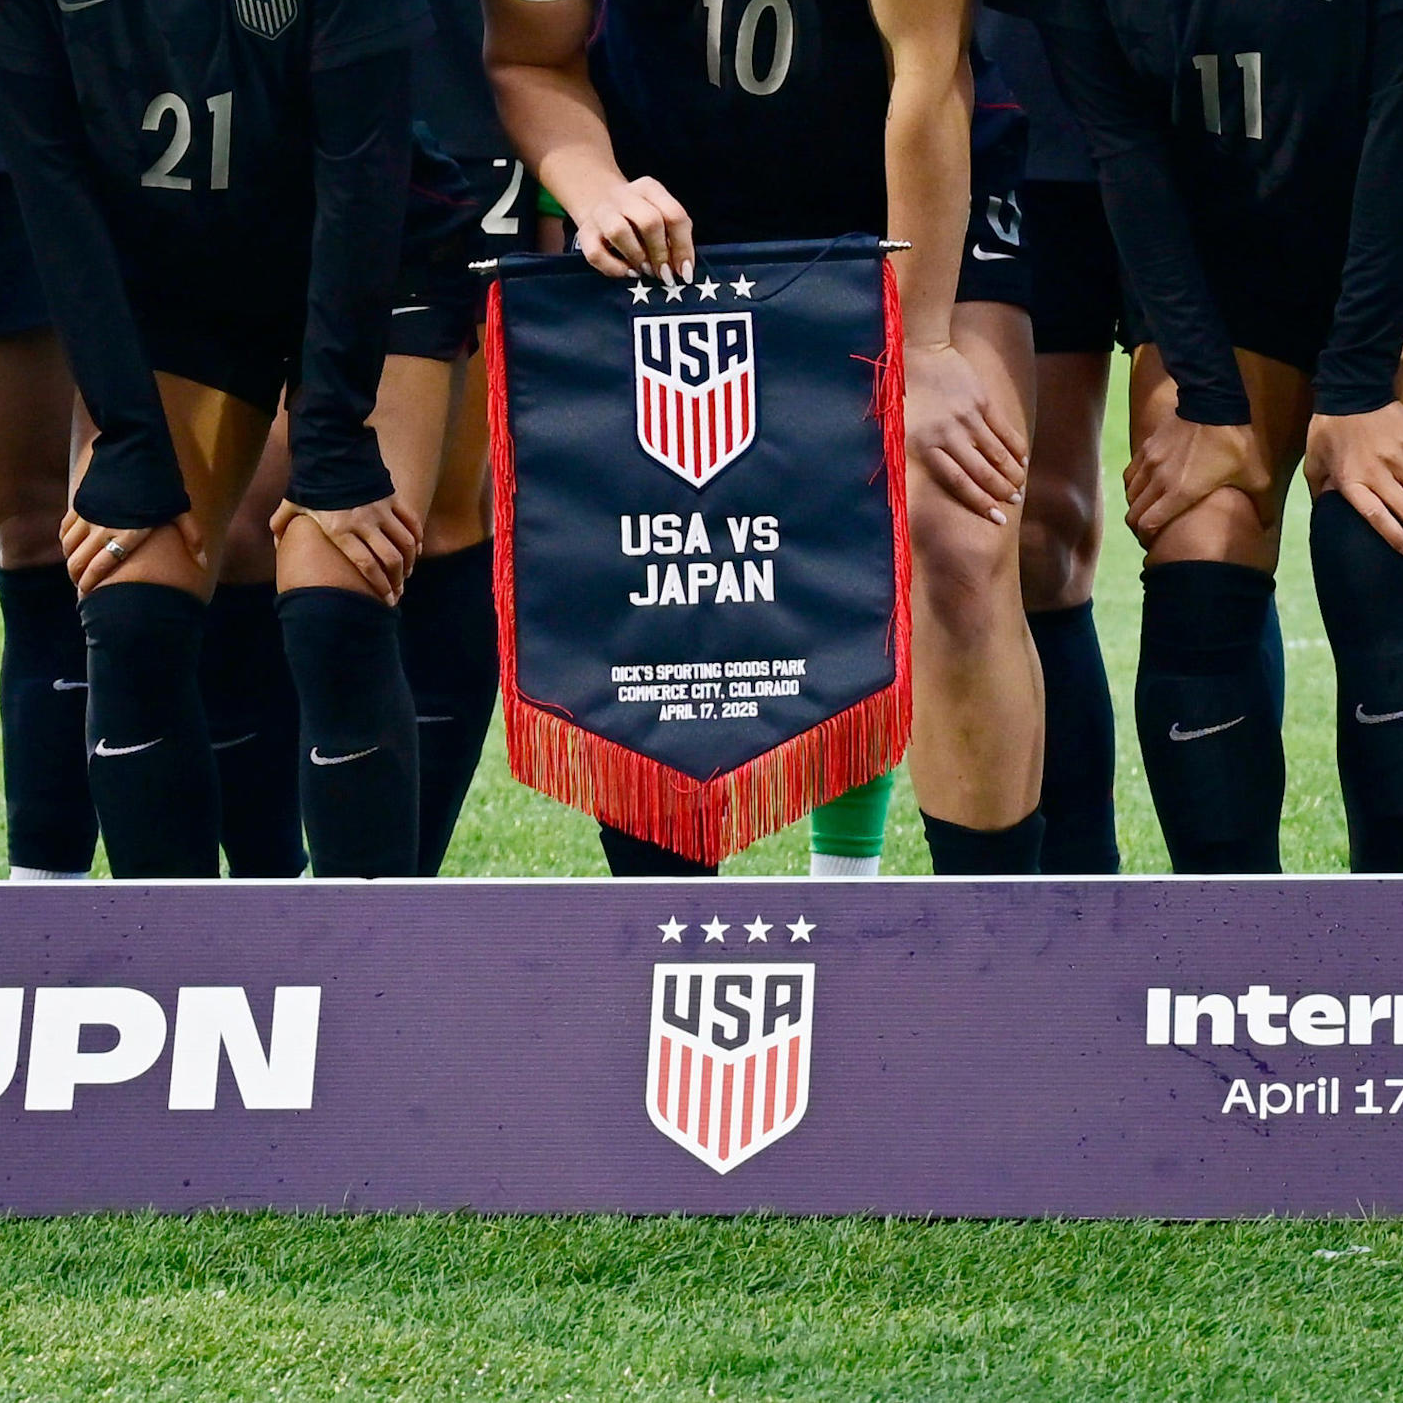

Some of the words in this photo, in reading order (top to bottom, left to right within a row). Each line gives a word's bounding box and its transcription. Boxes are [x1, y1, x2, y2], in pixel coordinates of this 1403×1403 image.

[1192, 52, 1262, 140] 11
[141, 91, 233, 190] 21
[640, 320, 748, 387] USA
[621, 512, 712, 556] USA
[629, 559, 775, 606] JAPAN
[611, 665, 654, 683] DICK'S
[655, 662, 723, 681] SPORTING
[724, 660, 770, 678] GOODS
[772, 659, 806, 676] PARK
[618, 683, 689, 702] COMMERCE
[690, 682, 726, 700] CITY,
[728, 680, 800, 698] COLORADO
[658, 703, 698, 722] APRIL
[699, 702, 718, 720] 17,
[721, 701, 759, 719] 2026
[663, 974, 804, 1051] USA
[1221, 1077, 1340, 1120] April
